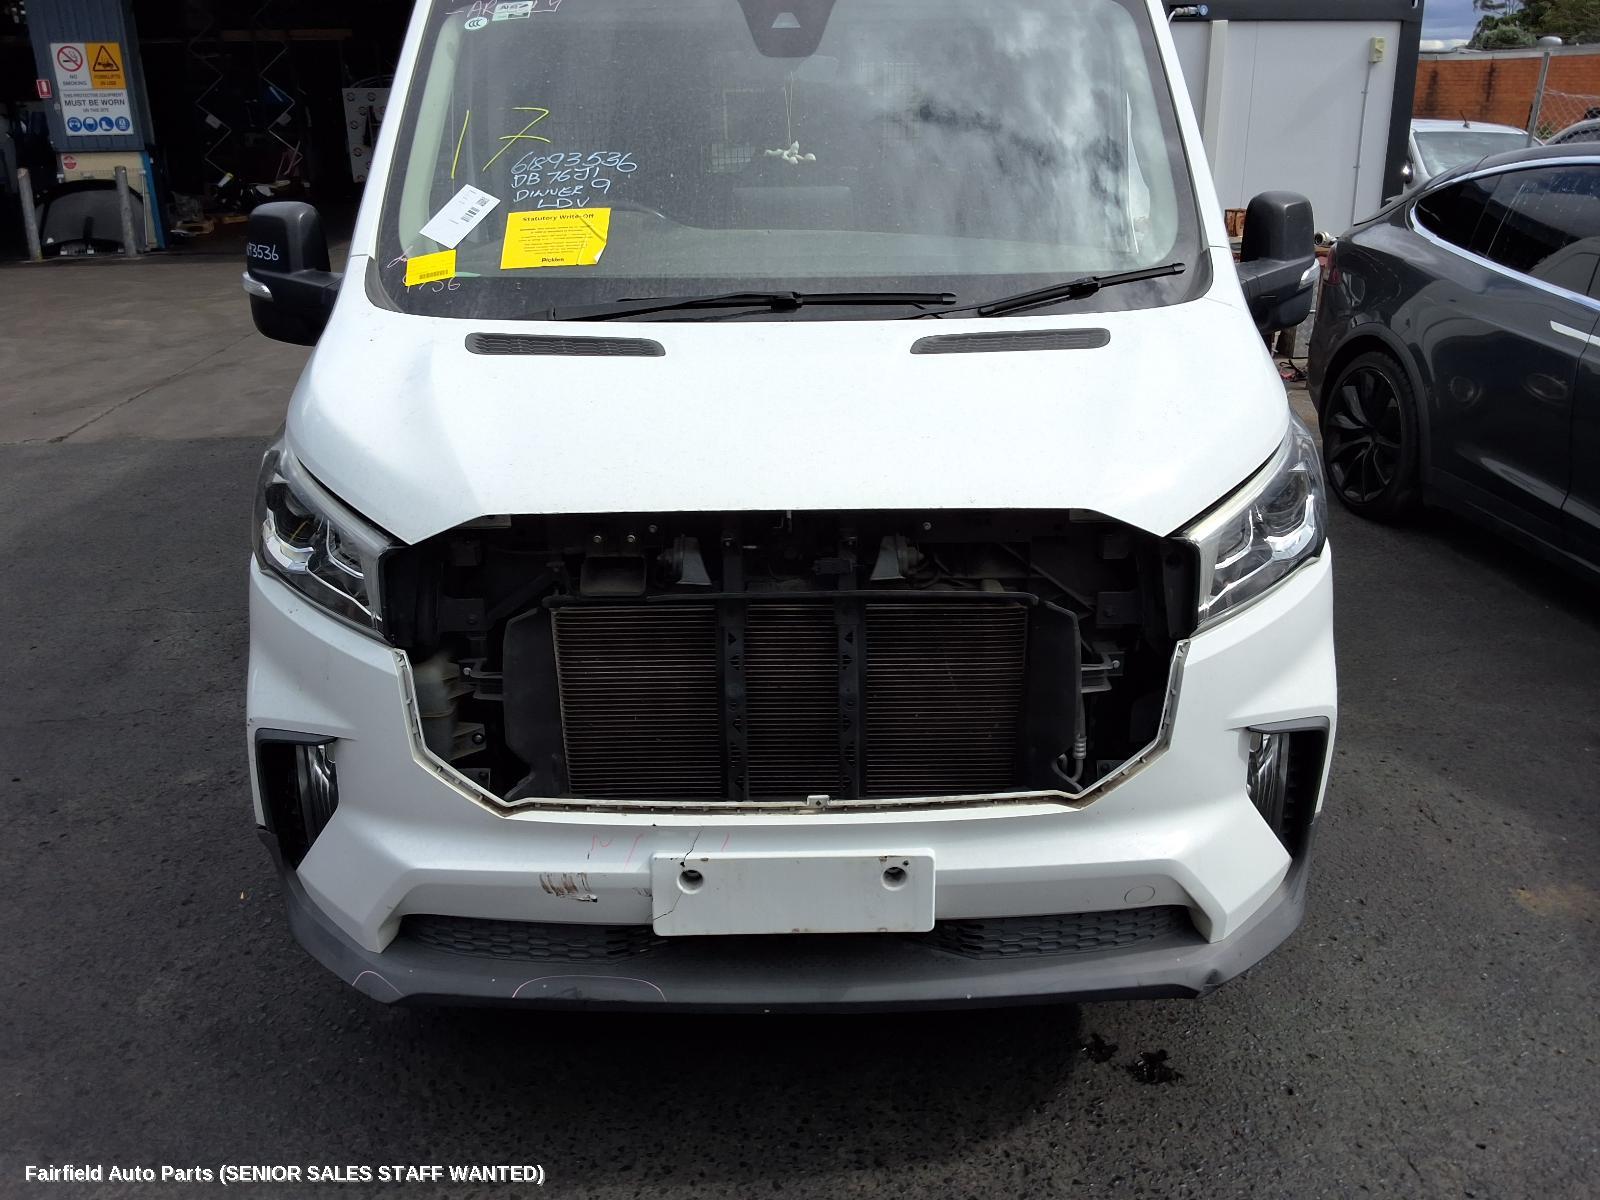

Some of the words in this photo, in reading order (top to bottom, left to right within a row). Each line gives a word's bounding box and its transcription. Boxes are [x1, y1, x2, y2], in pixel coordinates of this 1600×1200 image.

[64, 99, 86, 107] MUST
[88, 99, 98, 107] BE
[101, 98, 125, 106] WORN
[537, 196, 590, 209] LDV
